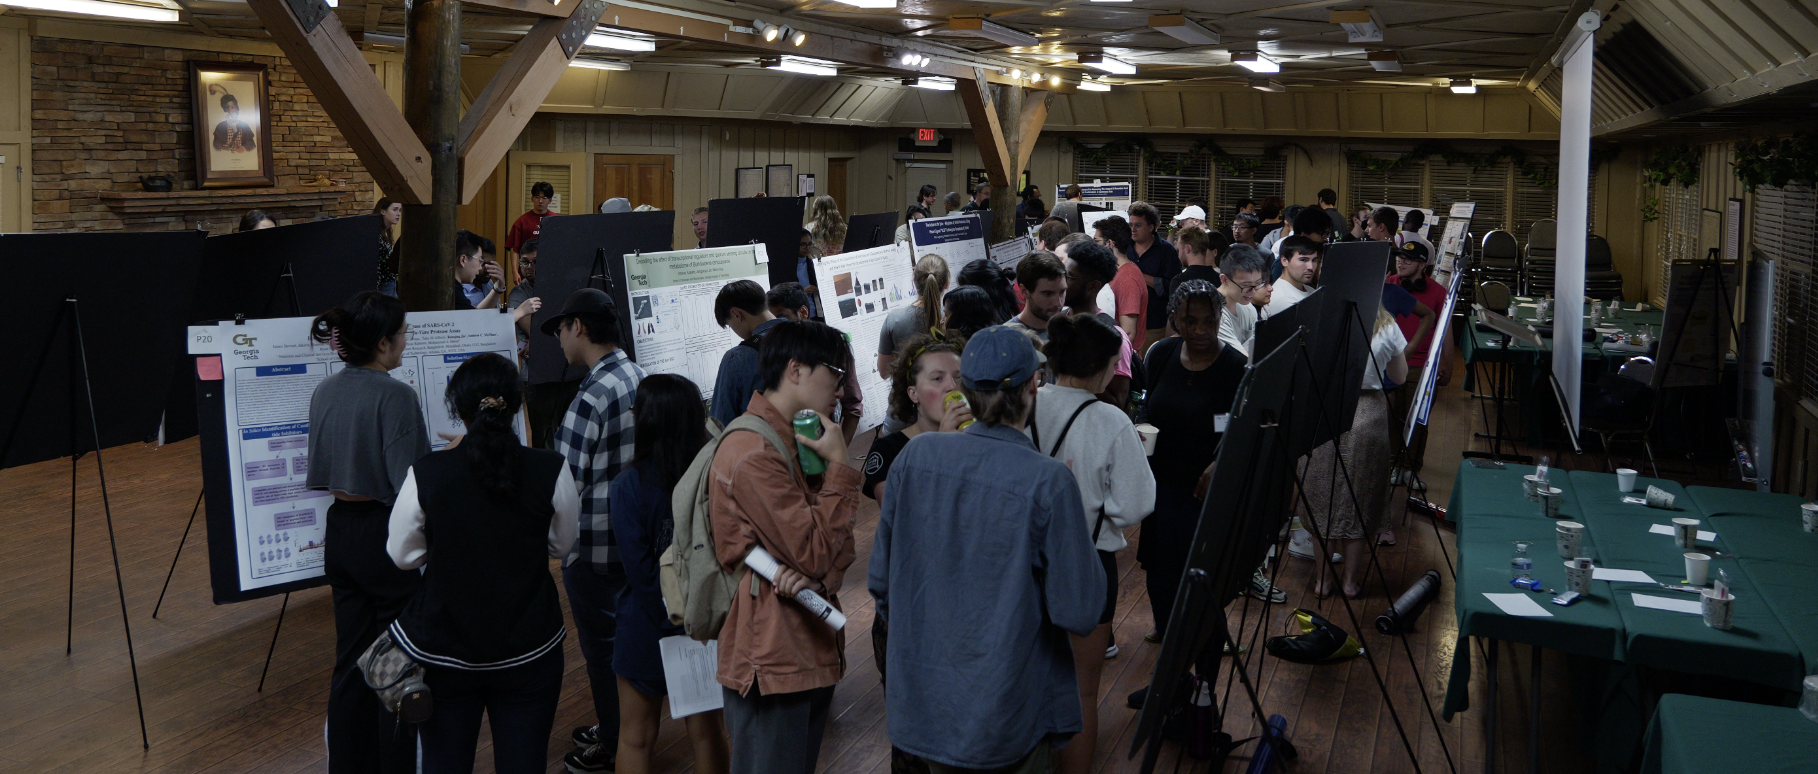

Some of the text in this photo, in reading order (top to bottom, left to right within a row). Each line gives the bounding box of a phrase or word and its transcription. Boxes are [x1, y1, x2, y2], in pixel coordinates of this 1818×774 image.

[919, 128, 935, 141] EXIT
[196, 335, 213, 343] P20
[232, 333, 257, 347] GT
